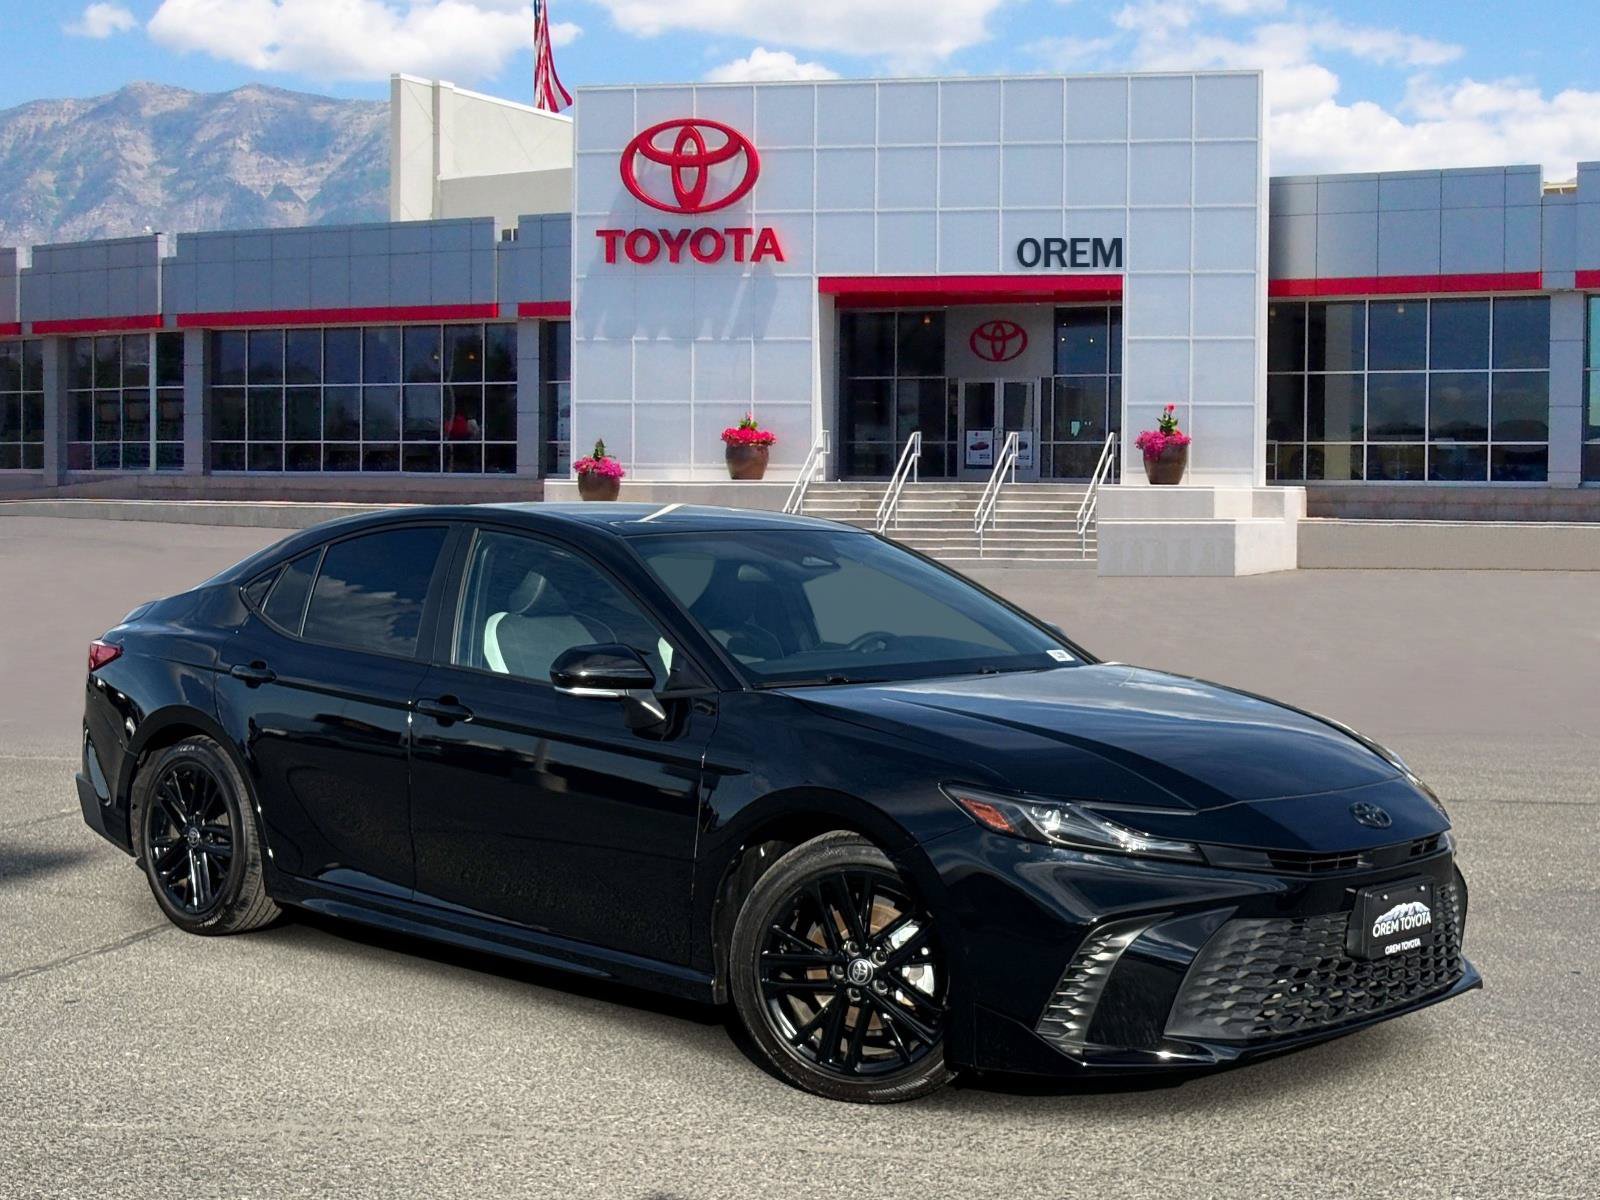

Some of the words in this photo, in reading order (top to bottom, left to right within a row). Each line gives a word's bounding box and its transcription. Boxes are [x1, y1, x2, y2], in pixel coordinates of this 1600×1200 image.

[596, 228, 784, 264] TOYOTA
[1017, 238, 1123, 268] OREM
[1372, 919, 1399, 937] OREM
[1401, 911, 1431, 930] TOYOTA
[1385, 943, 1401, 955] OREM
[1401, 938, 1421, 950] TOYOTA
